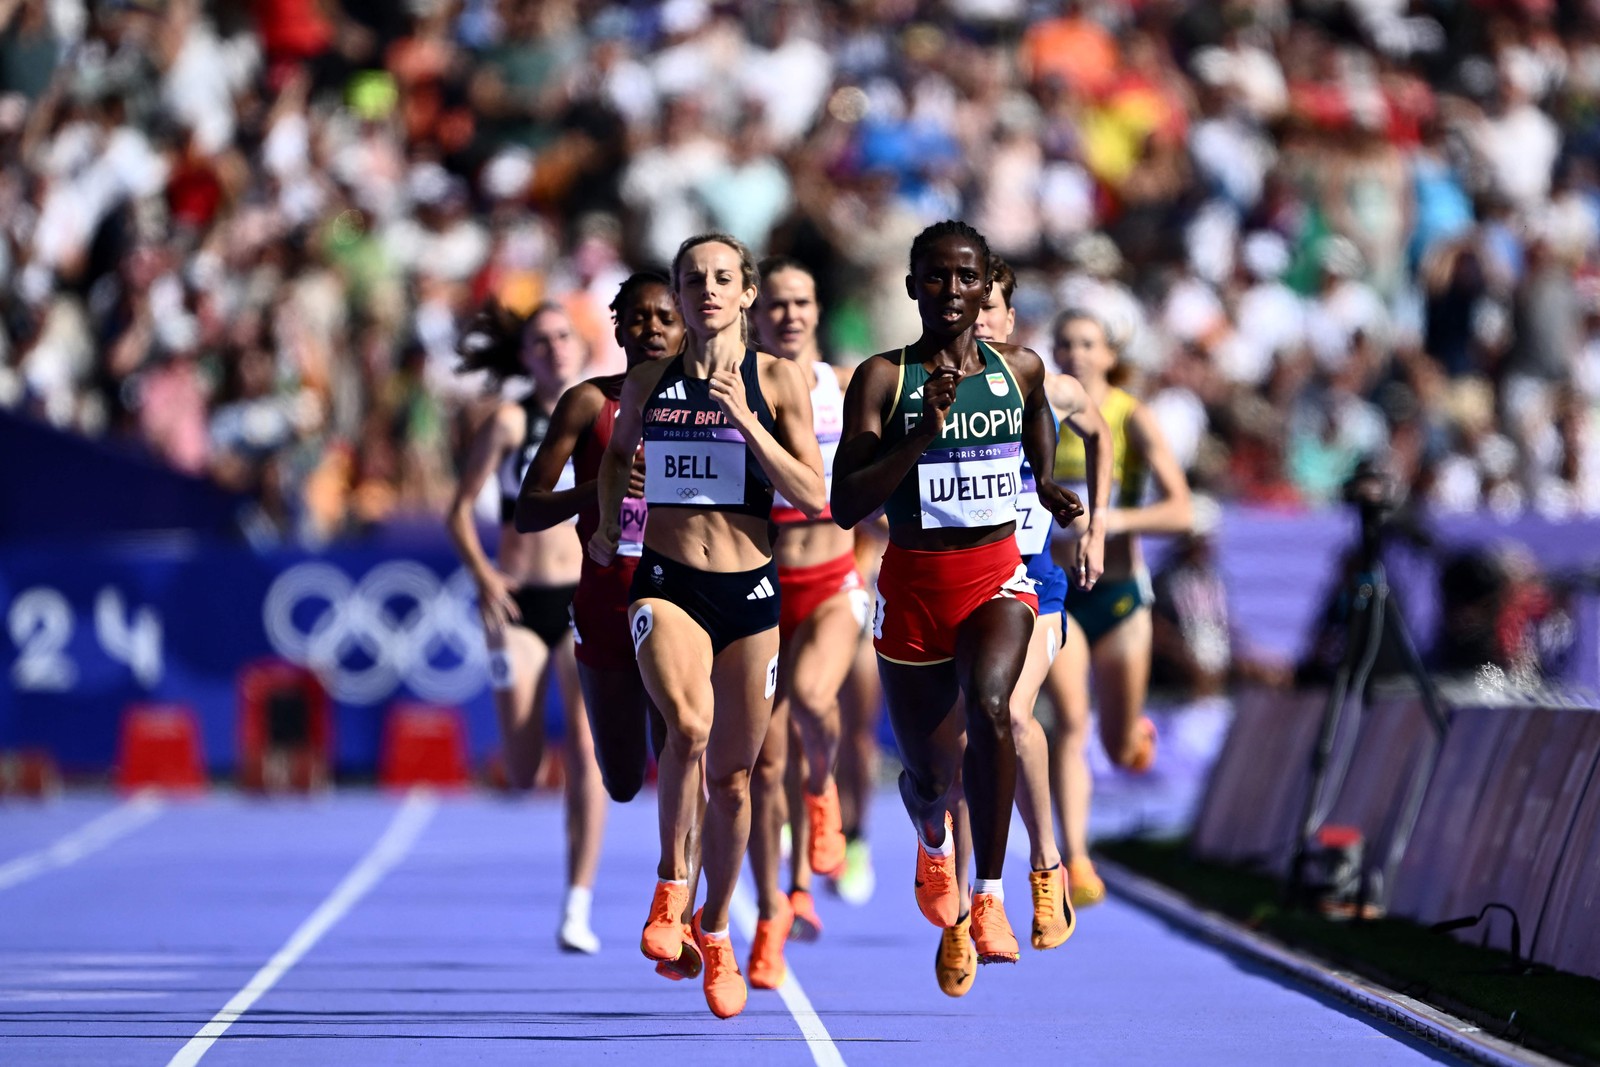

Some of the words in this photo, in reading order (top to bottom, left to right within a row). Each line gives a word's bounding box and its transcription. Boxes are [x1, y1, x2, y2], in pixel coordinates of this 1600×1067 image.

[646, 408, 691, 424] GREAT
[904, 408, 1022, 439] EHIOPIA
[663, 430, 690, 438] PARIS
[692, 430, 717, 438] 2024
[949, 450, 976, 459] PARIS
[979, 448, 1002, 457] 2024
[664, 455, 718, 479] BELL
[929, 472, 1016, 502] WELTEJI
